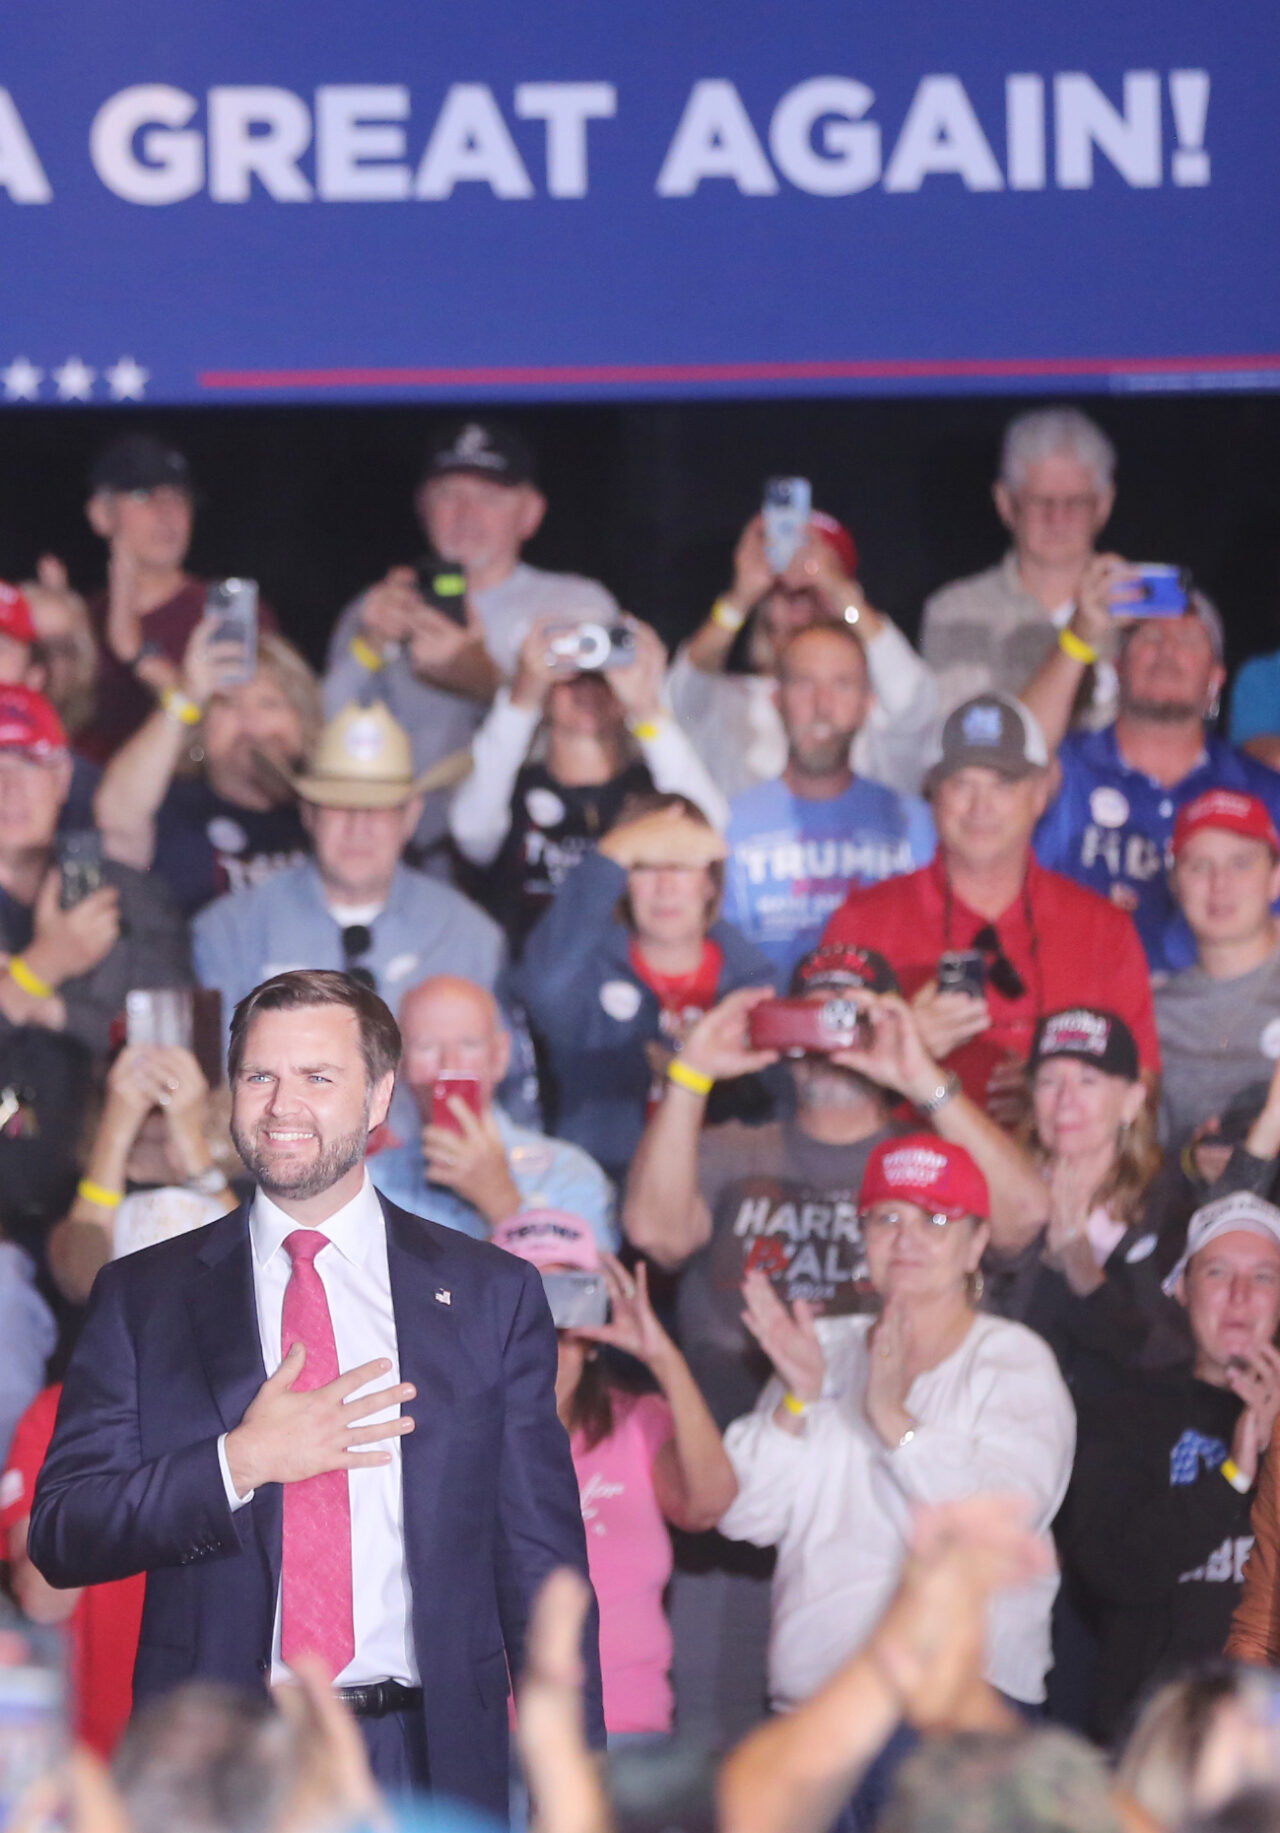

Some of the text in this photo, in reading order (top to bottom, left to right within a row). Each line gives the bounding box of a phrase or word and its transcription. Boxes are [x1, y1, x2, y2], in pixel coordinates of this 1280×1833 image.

[89, 81, 617, 207] GREAT
[656, 69, 1211, 197] AGAIN!
[733, 1197, 864, 1244] HARR
